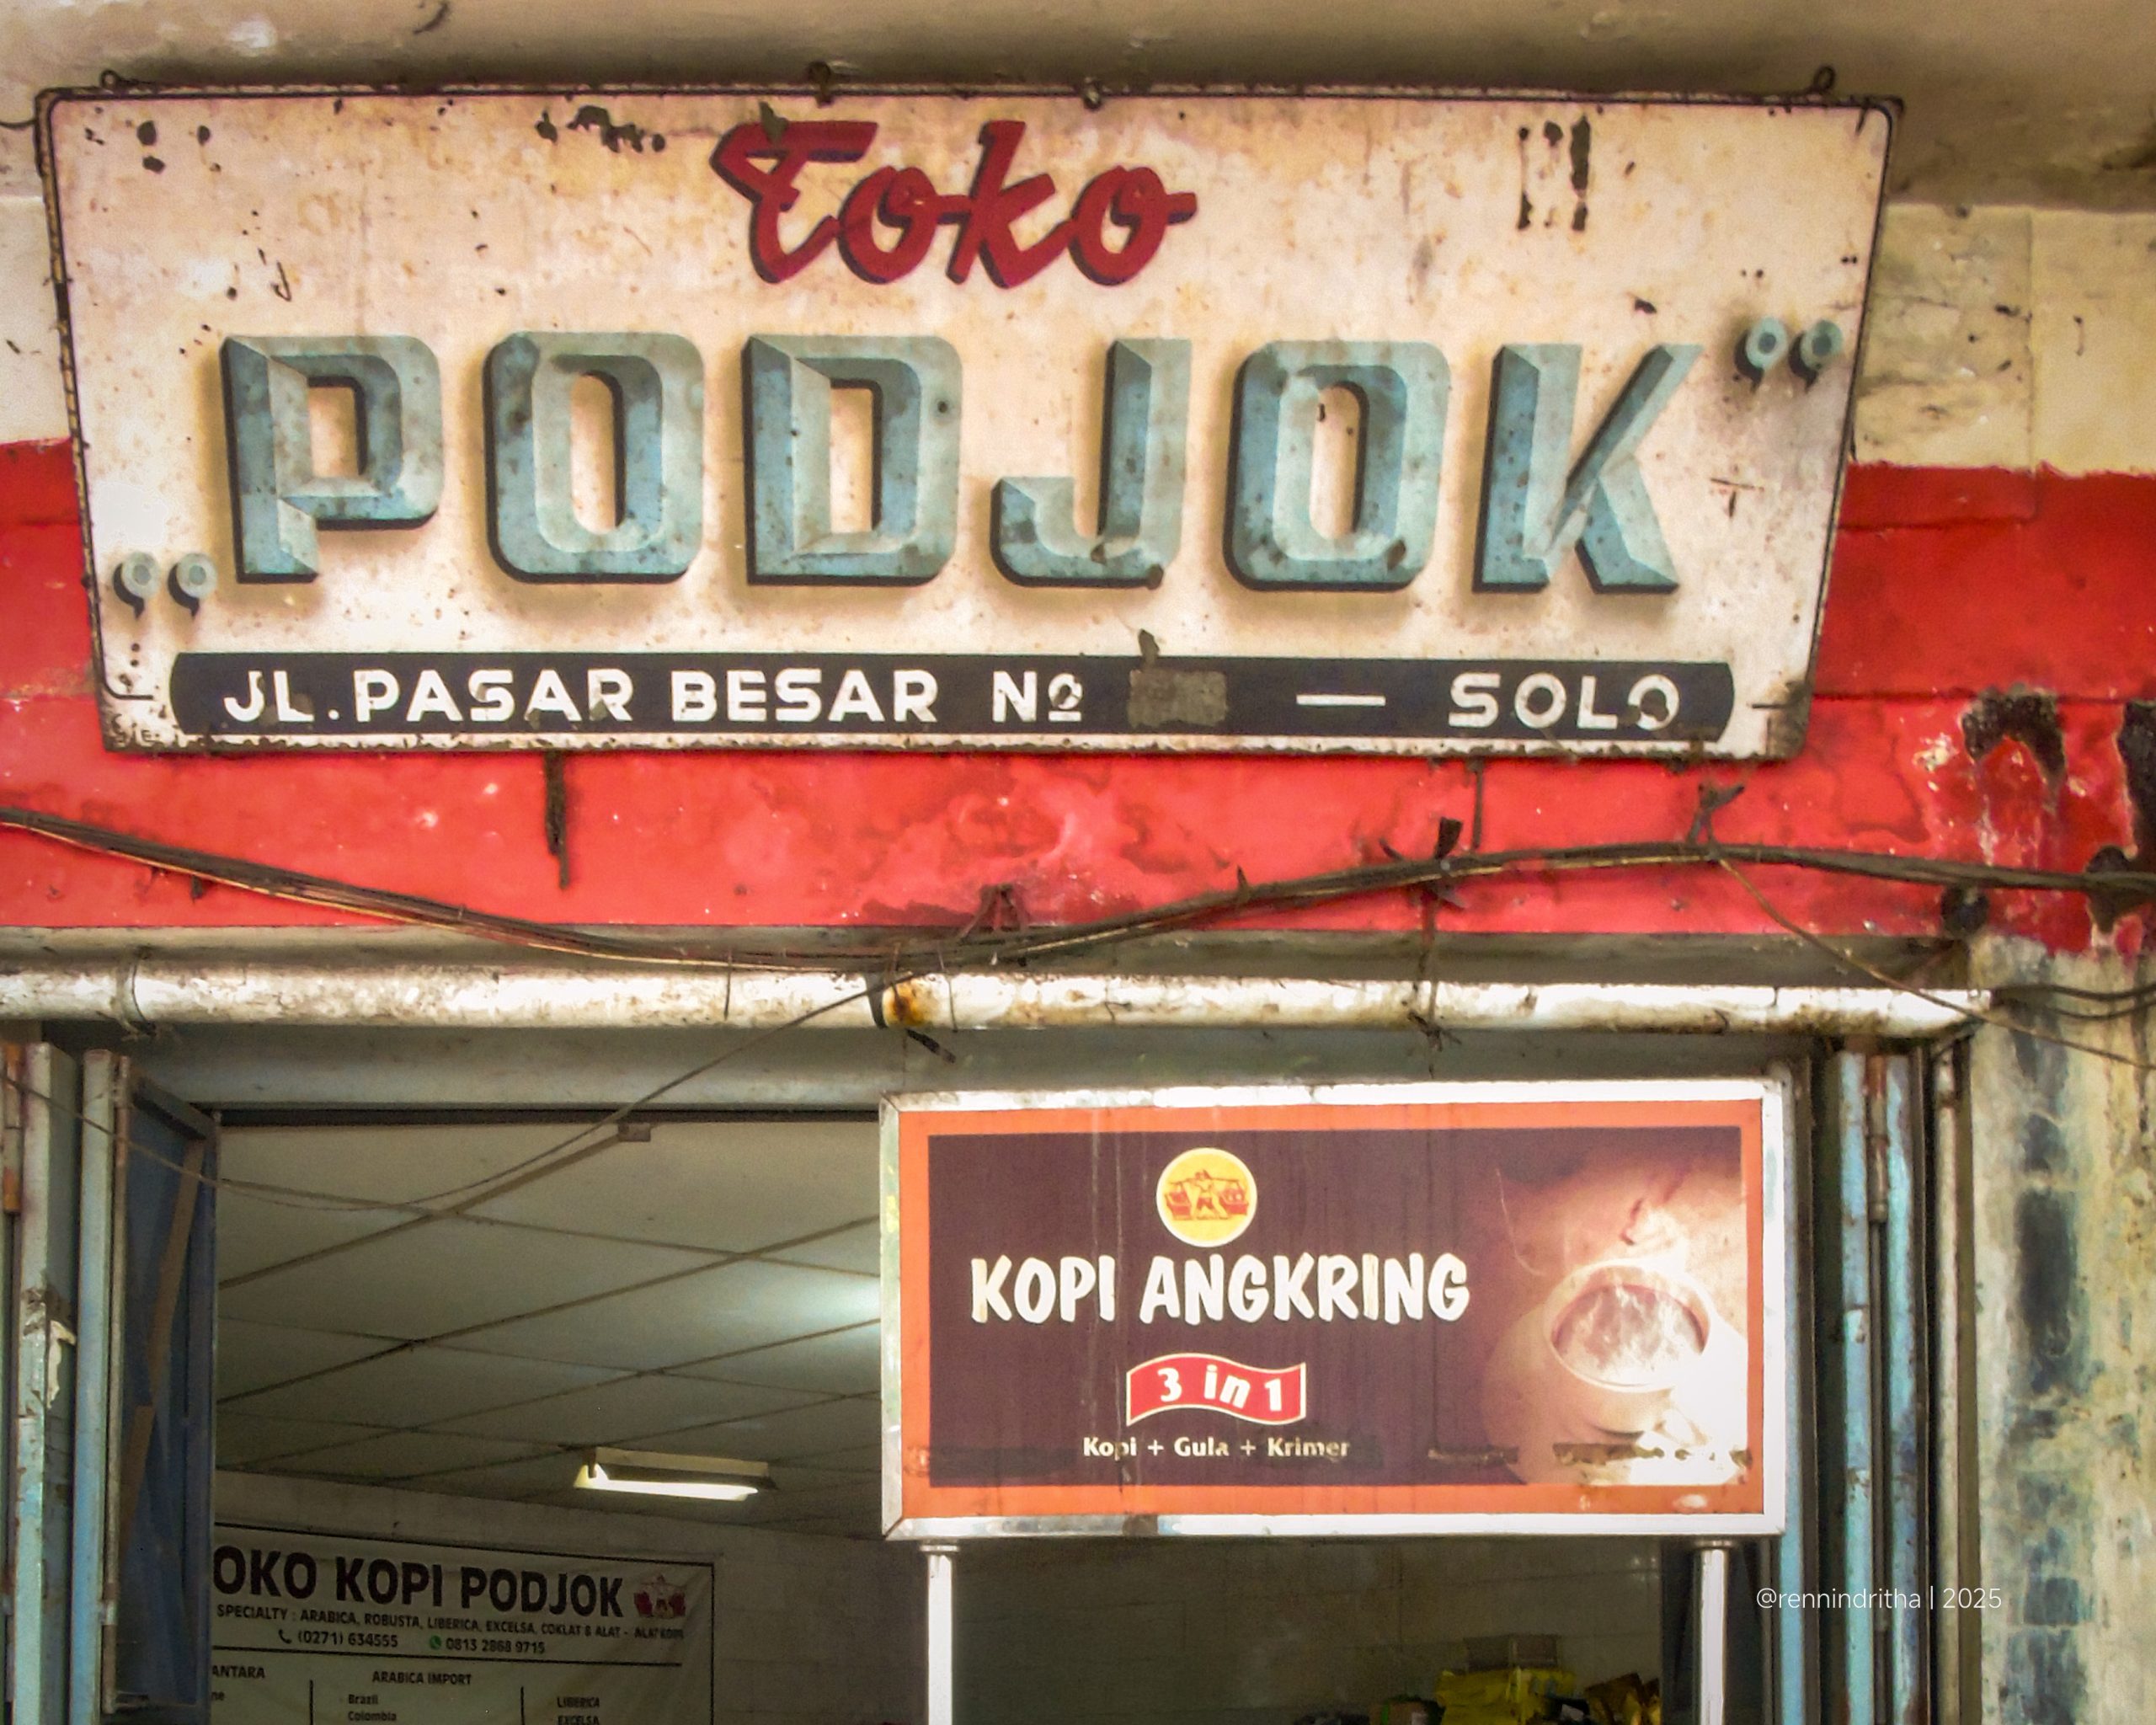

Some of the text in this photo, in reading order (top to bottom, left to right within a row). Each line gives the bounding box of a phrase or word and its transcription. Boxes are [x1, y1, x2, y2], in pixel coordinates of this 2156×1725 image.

[707, 120, 1198, 289] Toko
[671, 669, 938, 723] BESAR
[1448, 672, 1680, 730] SOLO
[971, 1252, 1471, 1326] KOPI ANGKRING
[1157, 1364, 1283, 1413] 3 in 1
[1082, 1436, 1138, 1461] Kopi
[1174, 1437, 1230, 1458] Gula
[1267, 1438, 1351, 1459] Krimer
[213, 1545, 624, 1618] OKO KOPI PODJOK
[216, 1604, 287, 1621] SPECIALTY
[541, 1623, 580, 1636] COKLAT
[595, 1626, 620, 1638] ALAT
[298, 1630, 398, 1648] (0271) 634555
[446, 1637, 477, 1652] 0813
[515, 1640, 546, 1654] 9715
[211, 1664, 265, 1679] ANTARA
[372, 1671, 472, 1685] ARABICA IMPORT
[349, 1694, 378, 1705] Brazil
[348, 1711, 397, 1722] Colombia
